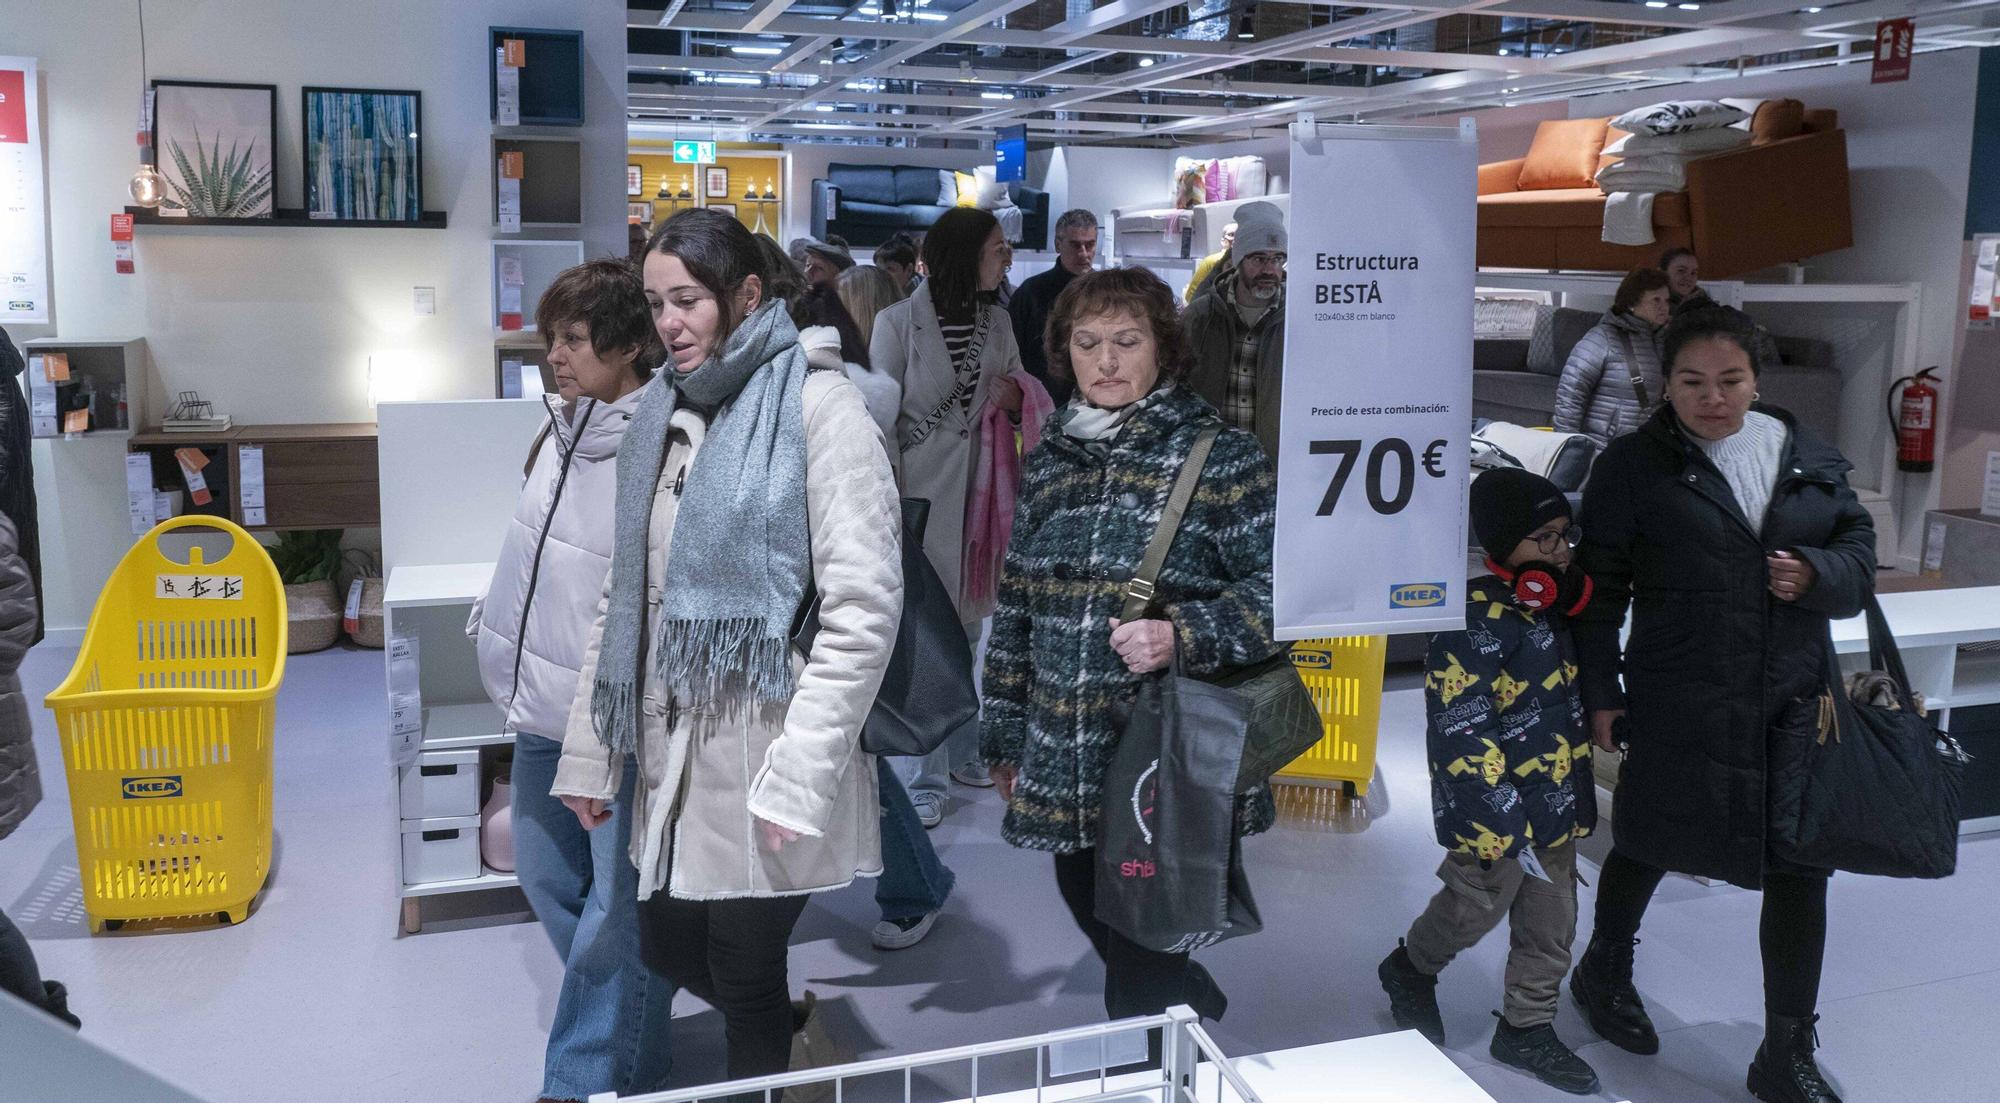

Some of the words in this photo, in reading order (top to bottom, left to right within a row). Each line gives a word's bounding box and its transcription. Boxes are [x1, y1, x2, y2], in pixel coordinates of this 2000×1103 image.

[1316, 253, 1419, 270] Estructura
[1315, 280, 1383, 304] BESTÅ
[1314, 312, 1355, 321] 120x40x38
[1356, 313, 1368, 321] cm
[1370, 312, 1396, 321] blanco
[1311, 406, 1343, 416] Precio
[1345, 406, 1358, 415] de
[1360, 406, 1382, 415] esta
[1384, 404, 1449, 415] combinación:
